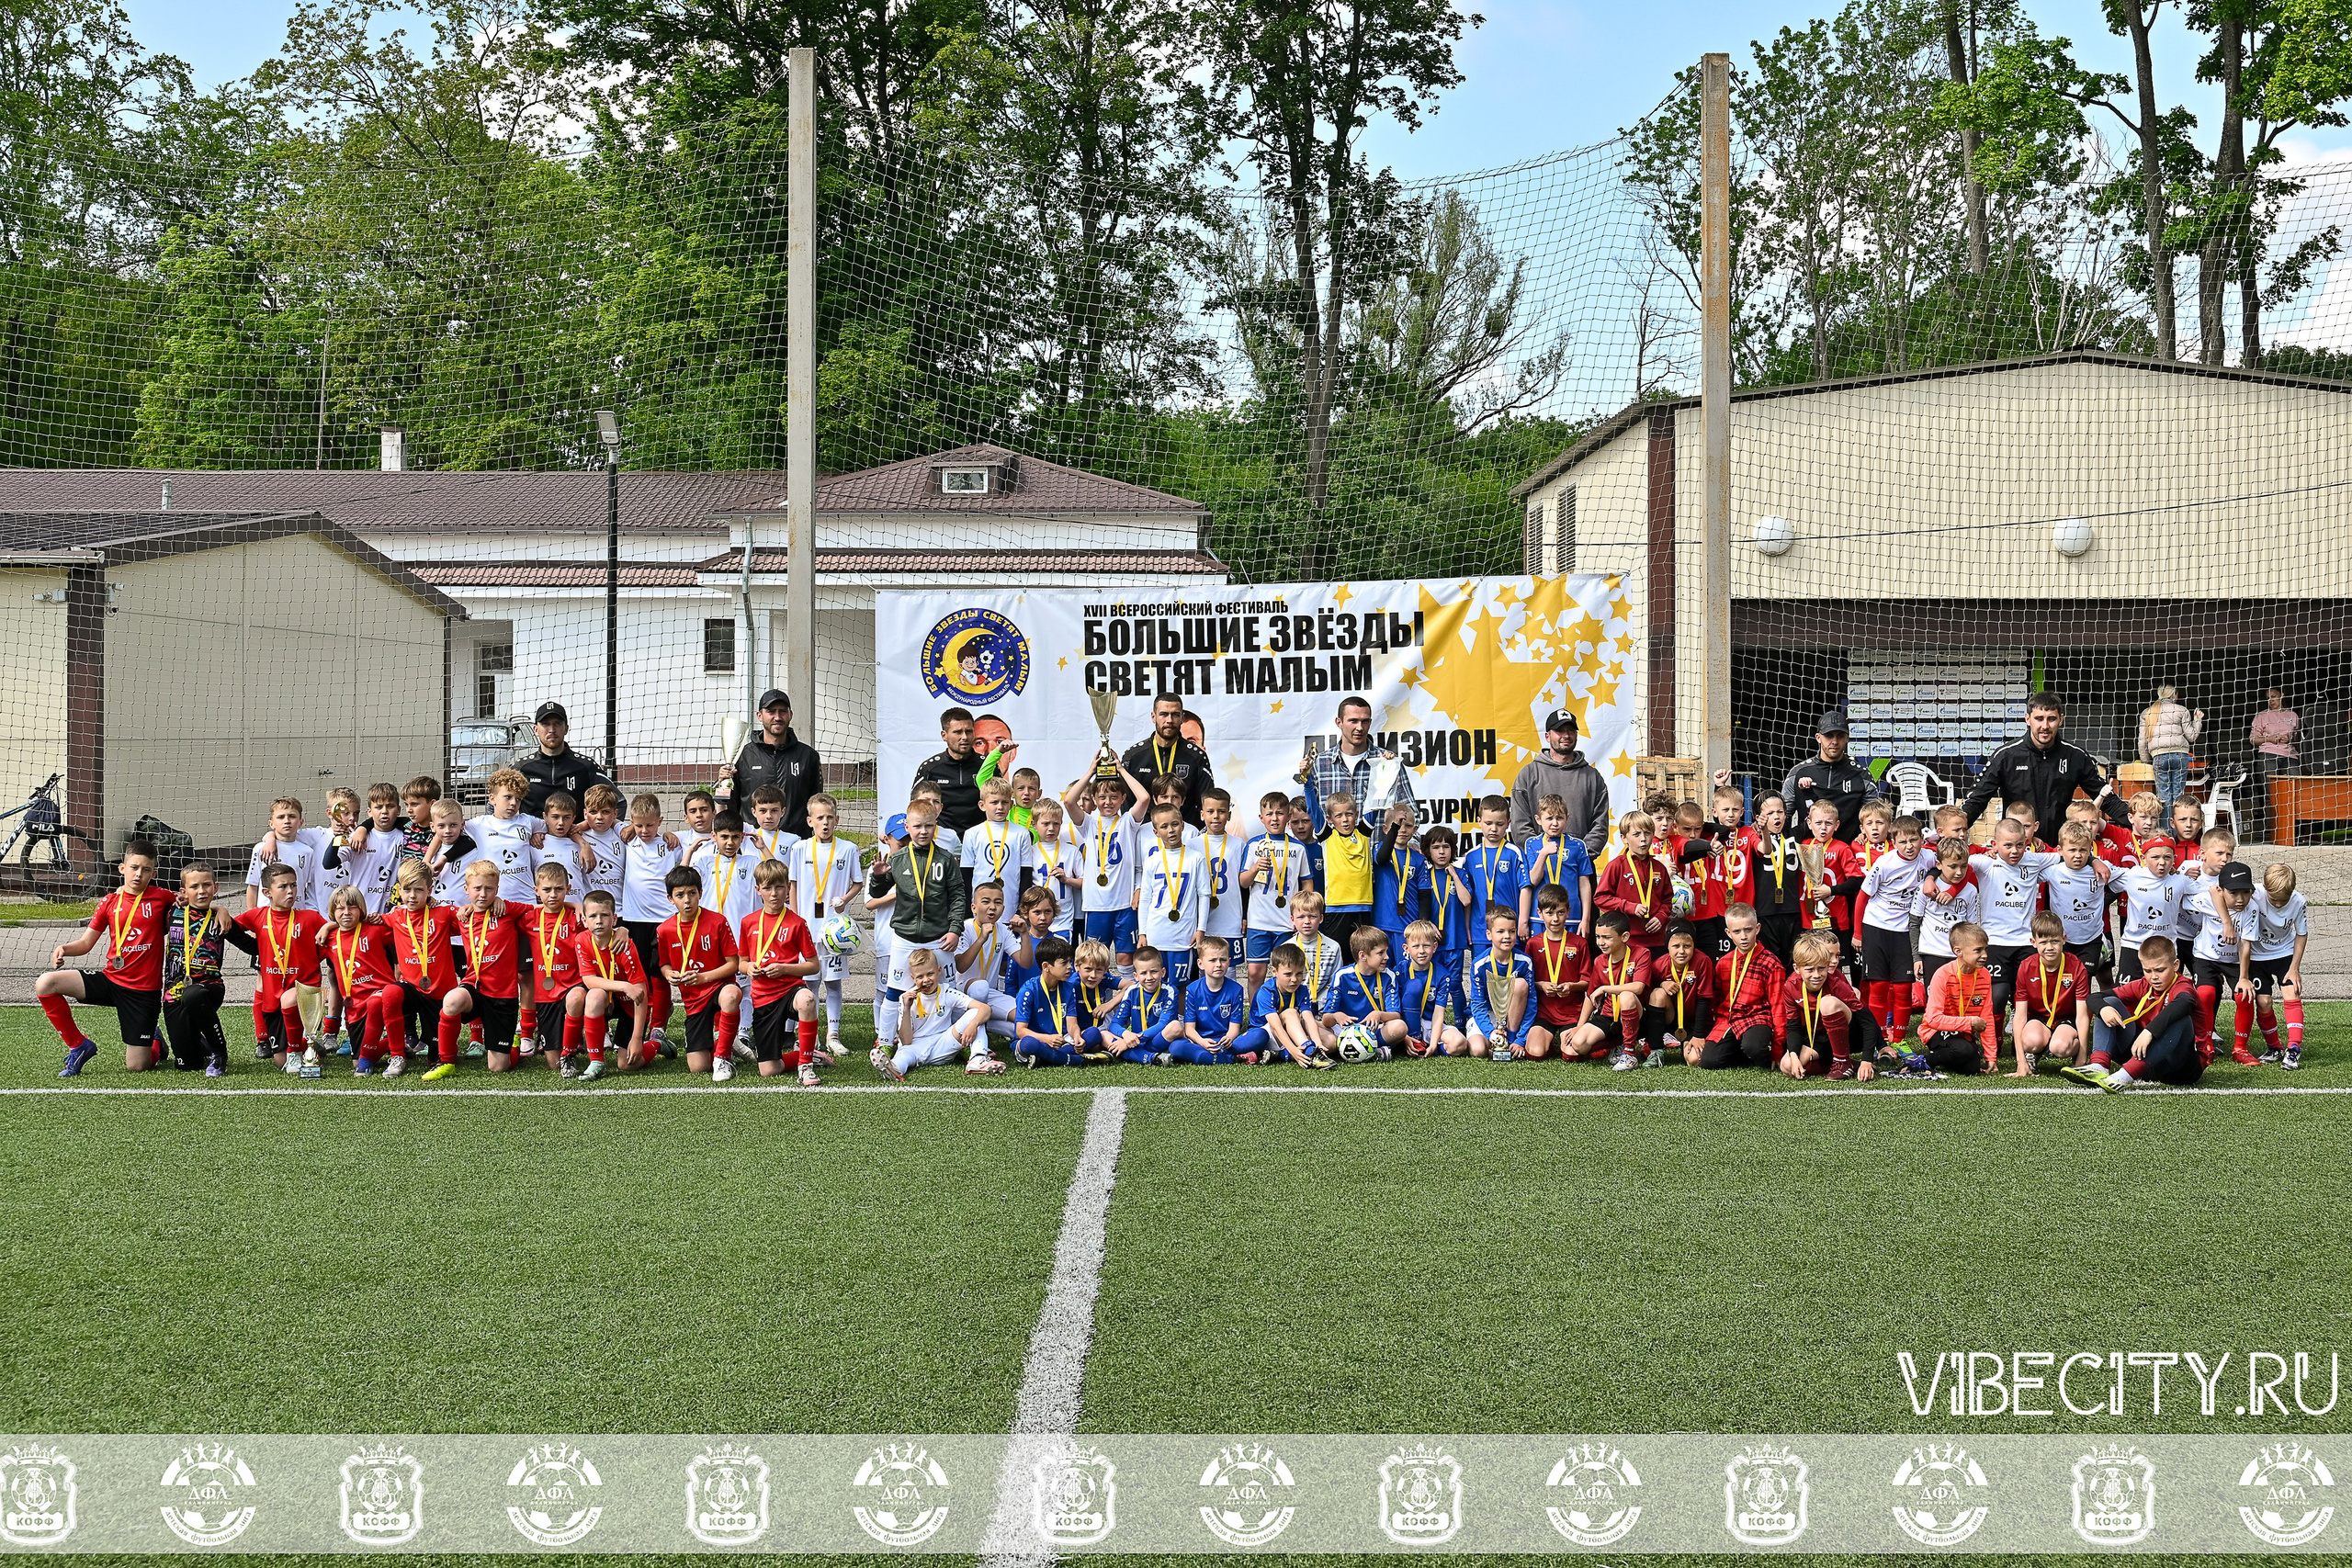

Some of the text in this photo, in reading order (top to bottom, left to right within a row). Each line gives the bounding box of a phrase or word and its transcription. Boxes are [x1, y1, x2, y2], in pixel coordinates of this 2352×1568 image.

[1084, 600, 1289, 617] XVII ВСЕРОССИЙСКИЙ ФЕСТИВАЛЬ
[1084, 607, 1424, 656] БОЛЬШИЕ ЗВЁЗДЫ
[923, 610, 1028, 693] БОЛЬШИЕ ЗВЕЗДЫ СВЕТЯТ МАЛЫМ
[1085, 655, 1372, 696] СВЕТЯТ МАЛЫМ
[932, 862, 944, 881] 10
[1628, 877, 1634, 886] 9
[1154, 873, 1191, 909] 77
[1234, 940, 1241, 953] 8
[1719, 939, 1730, 952] 19
[829, 956, 842, 968] 24
[944, 964, 955, 979] 11
[1174, 964, 1188, 977] 77
